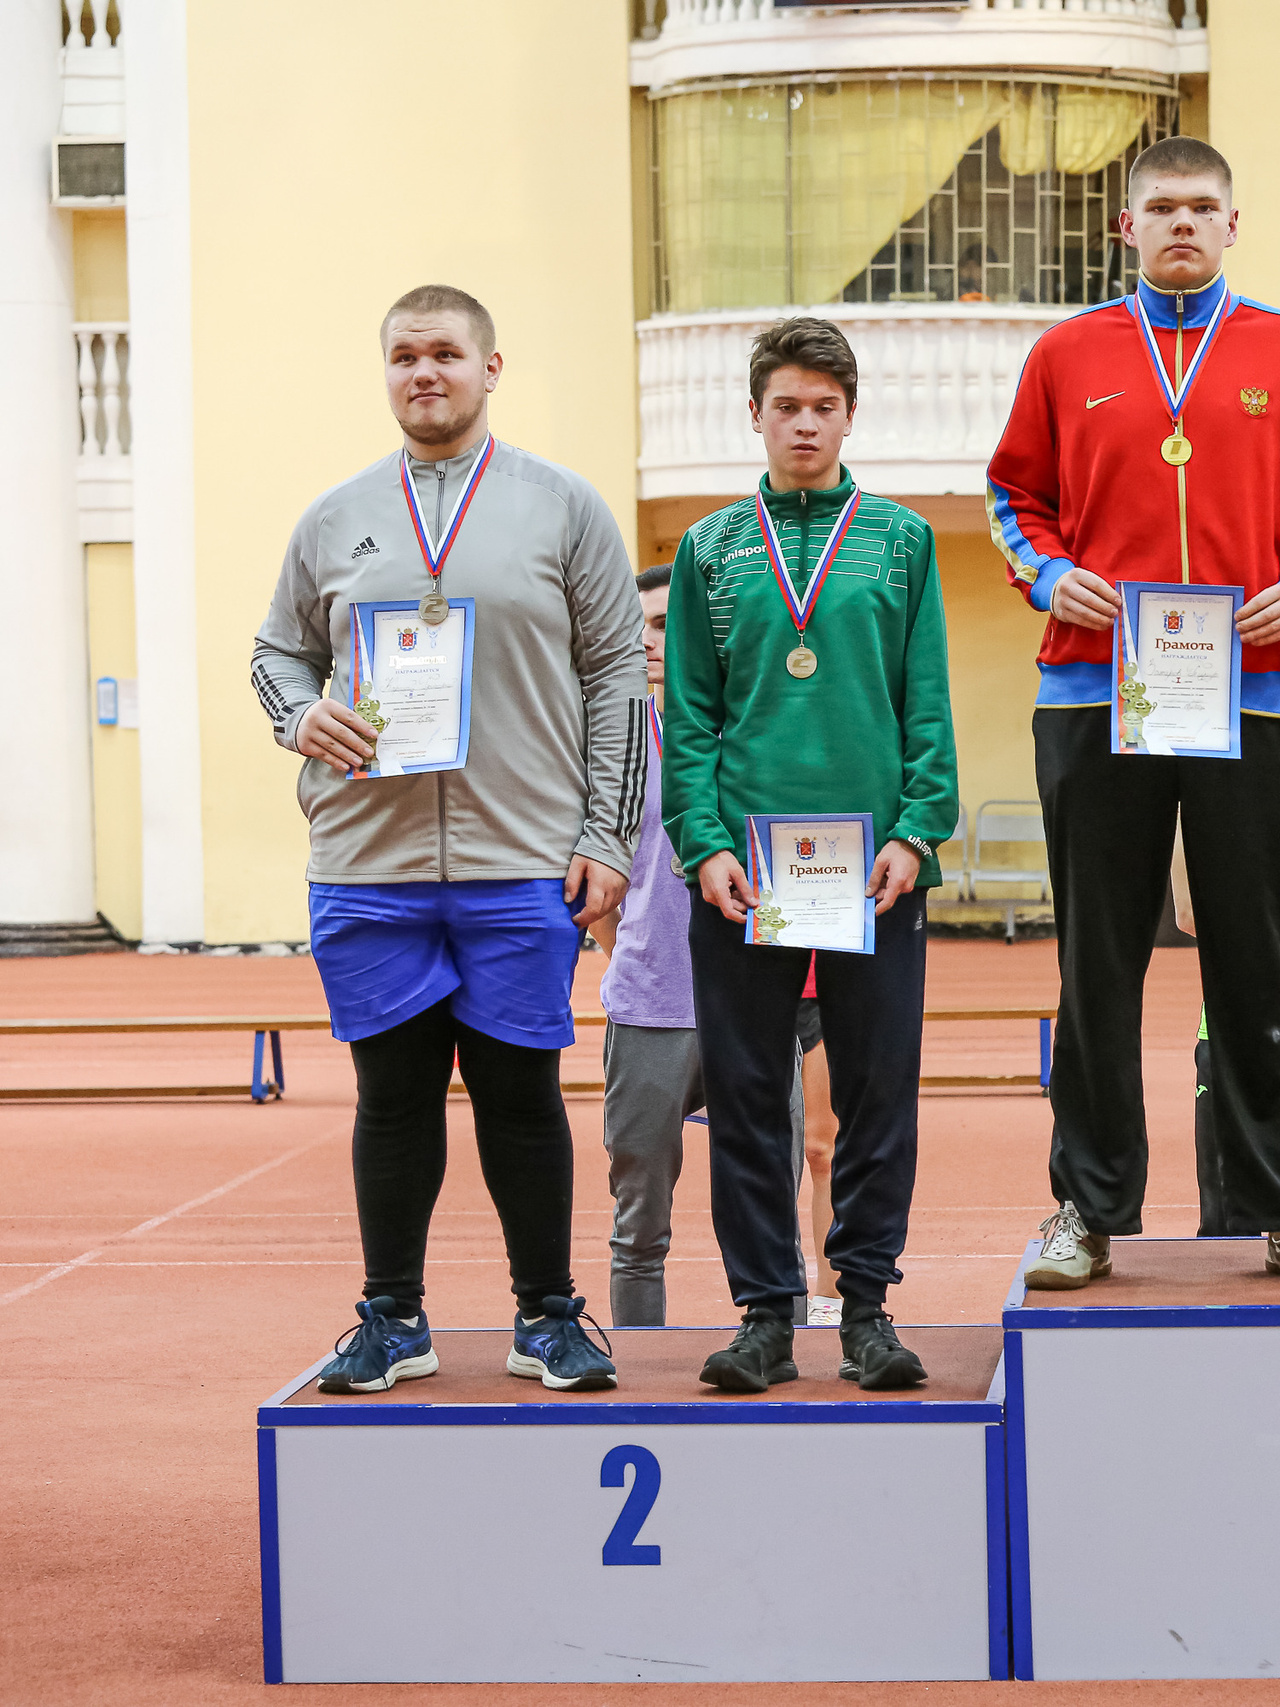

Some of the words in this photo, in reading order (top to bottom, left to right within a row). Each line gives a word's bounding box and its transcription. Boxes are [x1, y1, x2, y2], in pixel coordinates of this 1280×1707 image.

[351, 547, 380, 559] adidas
[721, 544, 767, 565] uhlspor
[1155, 638, 1214, 652] Грамота
[789, 864, 848, 878] Грамота
[599, 1444, 662, 1566] 2
